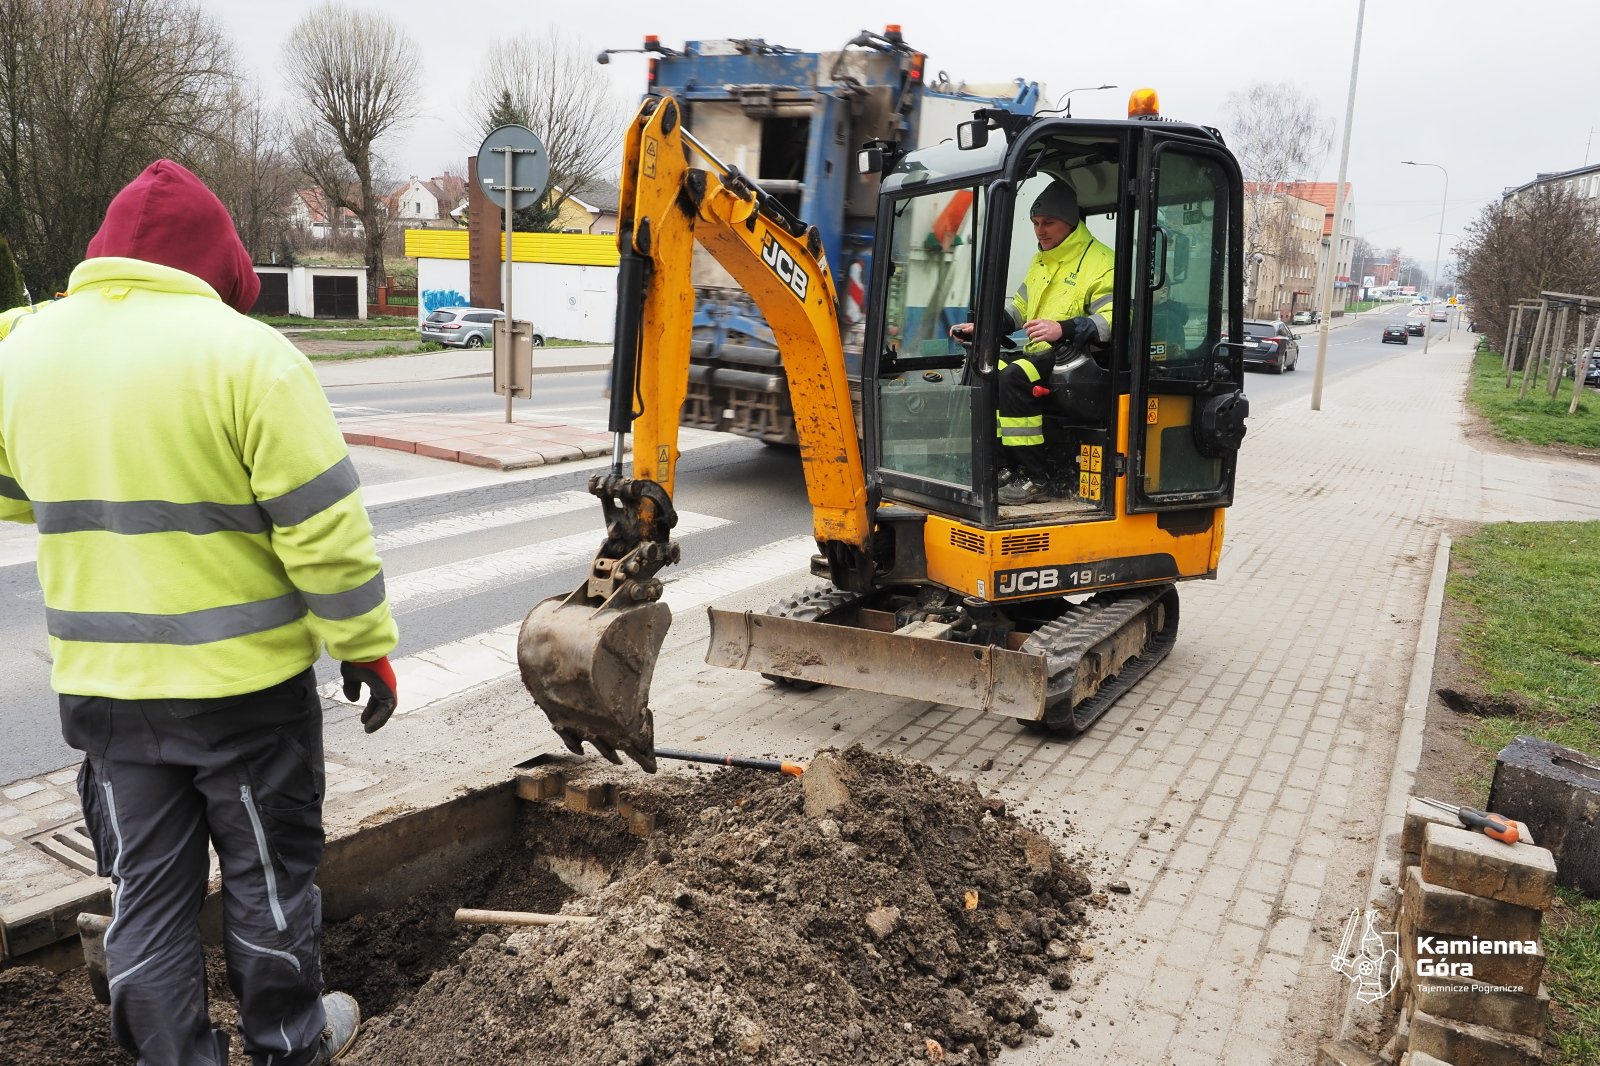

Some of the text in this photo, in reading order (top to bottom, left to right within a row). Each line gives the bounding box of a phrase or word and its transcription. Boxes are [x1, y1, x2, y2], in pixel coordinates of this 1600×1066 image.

[762, 237, 808, 299] JCB
[1150, 345, 1165, 355] CB
[999, 568, 1059, 594] JCB
[1069, 570, 1092, 585] 19
